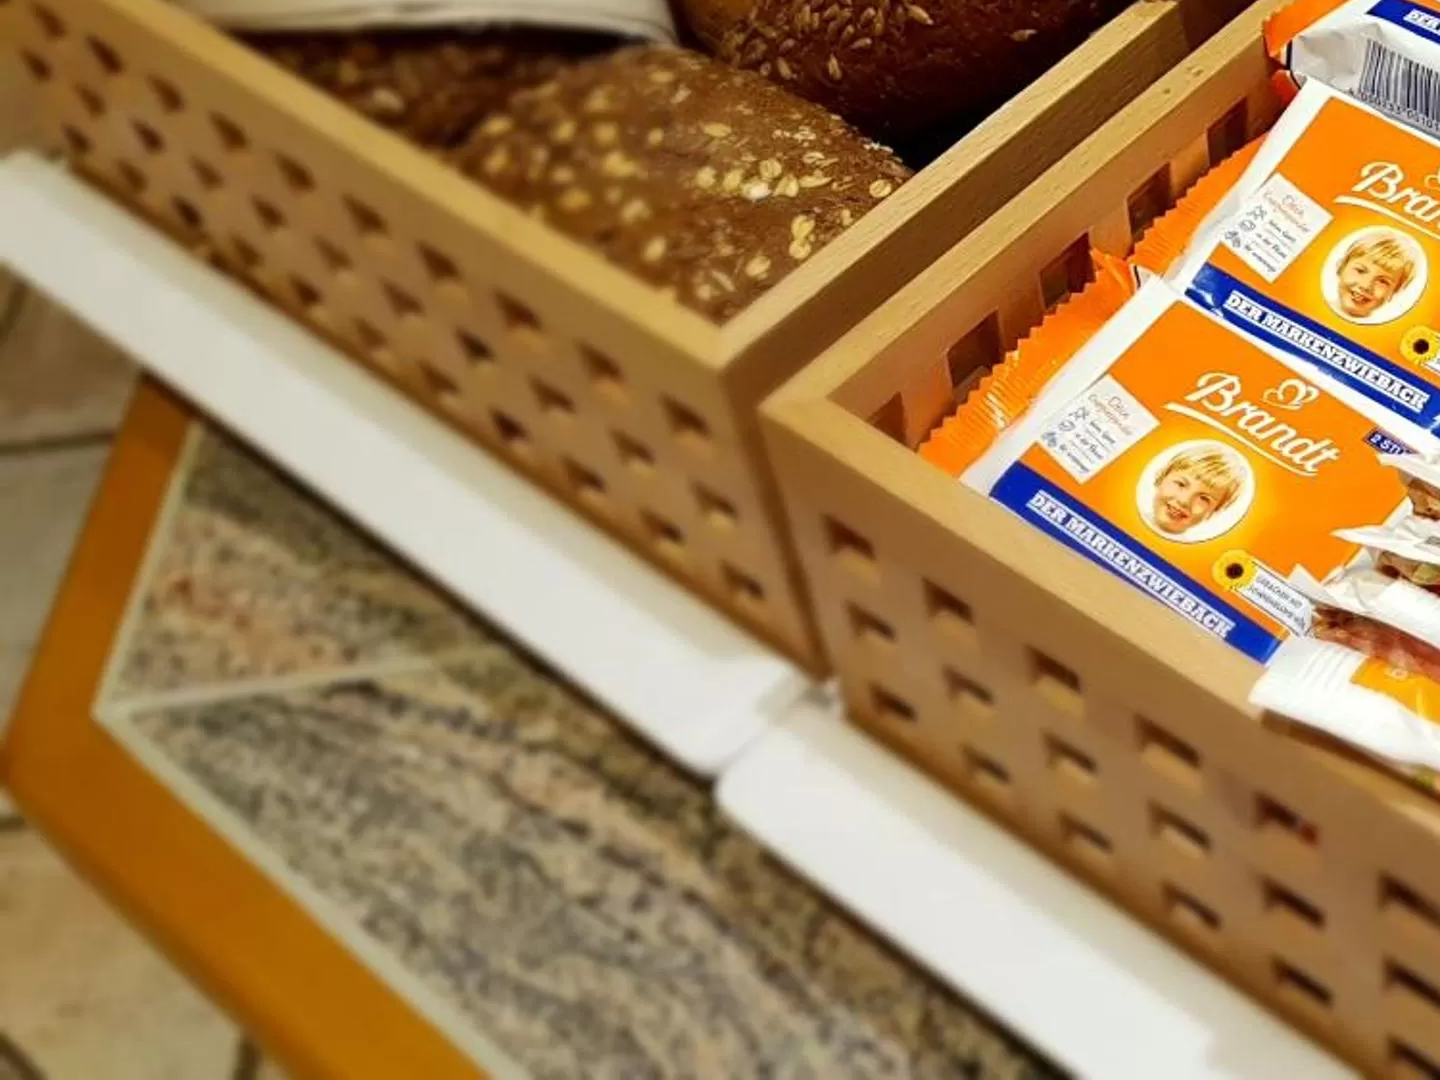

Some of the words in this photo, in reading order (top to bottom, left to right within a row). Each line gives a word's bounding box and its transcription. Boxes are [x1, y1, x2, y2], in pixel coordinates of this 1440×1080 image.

[1223, 291, 1264, 320] DER
[1261, 311, 1430, 413] MARKENZWIEBACK
[1182, 371, 1342, 474] Brandt
[1027, 490, 1068, 526] DER
[1064, 511, 1235, 639] MARKENZWIEBACK
